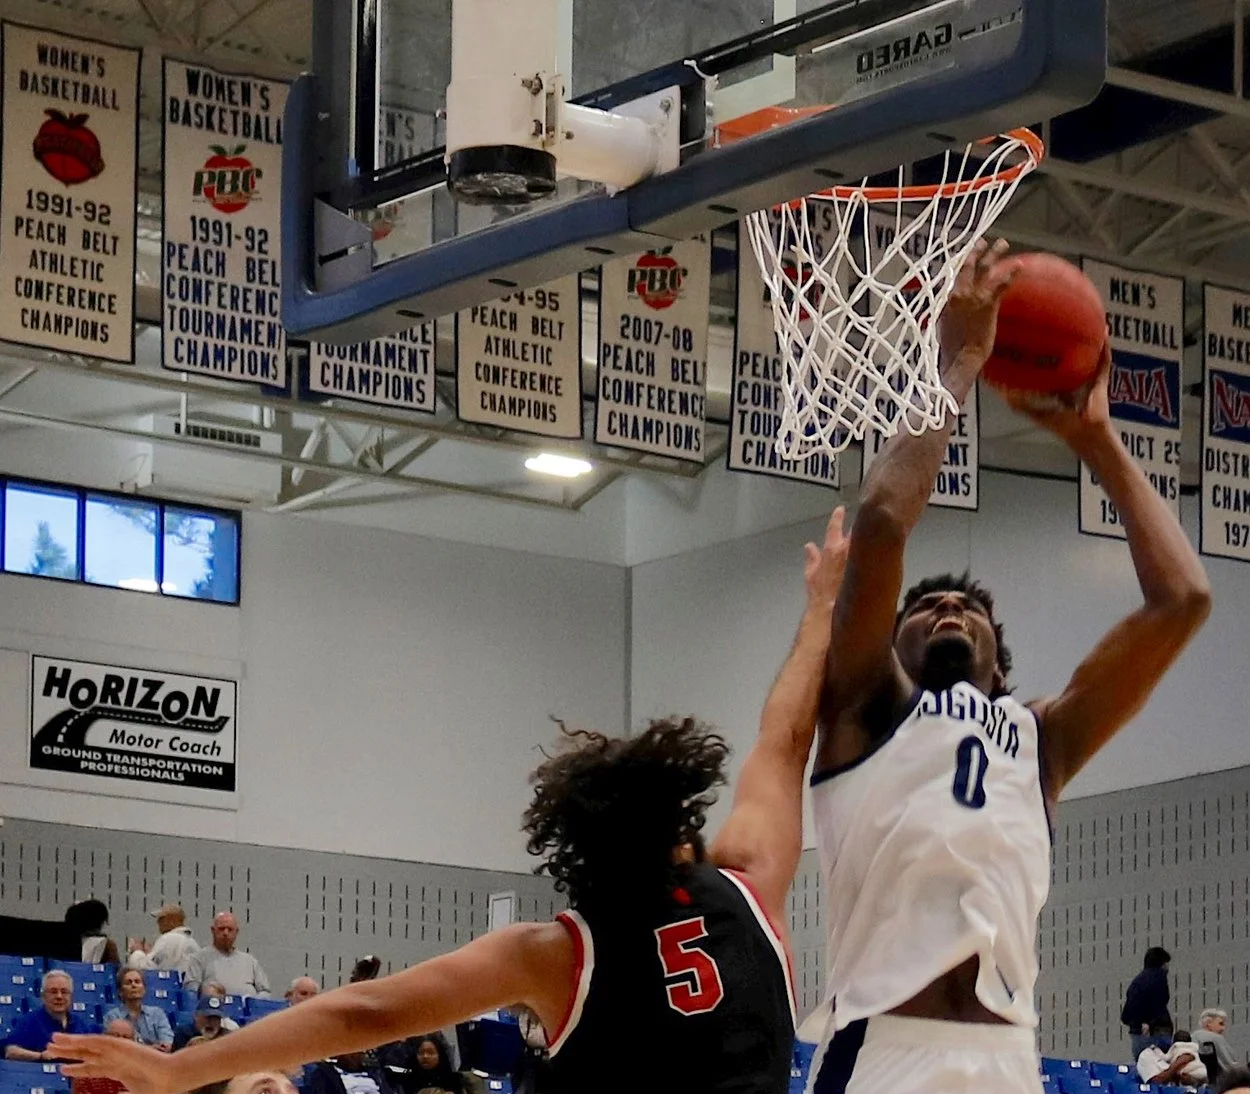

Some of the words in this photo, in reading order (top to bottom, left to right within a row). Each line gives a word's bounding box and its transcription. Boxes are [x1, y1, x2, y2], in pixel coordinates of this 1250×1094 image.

[37, 44, 105, 78] WOMEN'S
[19, 70, 120, 111] BASKETBALL
[186, 69, 270, 111] WOMEN'S
[169, 97, 282, 145] BASKETBALL
[192, 167, 263, 197] PBC
[26, 188, 112, 225] 1991-92
[15, 217, 66, 246] PEACH
[82, 230, 120, 256] BELT
[190, 215, 269, 255] 1991-92
[29, 249, 104, 282] ATHLETIC
[166, 241, 225, 278] PEACH
[245, 261, 281, 288] BEL
[627, 268, 688, 294] PBC
[15, 276, 117, 315] CONFERENCE
[166, 273, 280, 317] CONFERENC
[501, 288, 560, 312] 4-95
[1110, 277, 1156, 308] MEN'S
[20, 308, 109, 343] CHAMPIONS
[471, 305, 517, 332] PEACH
[531, 315, 565, 342] BELT
[620, 314, 693, 353] 2007-08
[1105, 313, 1179, 350] SKETBALL
[173, 337, 279, 381] CHAMPIONS
[484, 334, 553, 367] ATHLETIC
[602, 342, 655, 377] PEACH
[739, 351, 792, 386] PEAC
[320, 361, 426, 404] CHAMPIONS
[475, 361, 563, 397] CONFERENCE
[480, 390, 557, 423] CHAMPIONS
[607, 410, 700, 452] CHAMPIONS
[1121, 431, 1154, 461] RICT
[1164, 440, 1181, 465] 25
[42, 745, 102, 761] GROUND
[106, 752, 223, 776] TRANSPORTATION
[109, 728, 163, 750] Motor
[169, 736, 221, 757] Coach
[80, 761, 185, 782] PROFESSIONALS
[953, 735, 989, 809] 0
[653, 916, 725, 1017] 5
